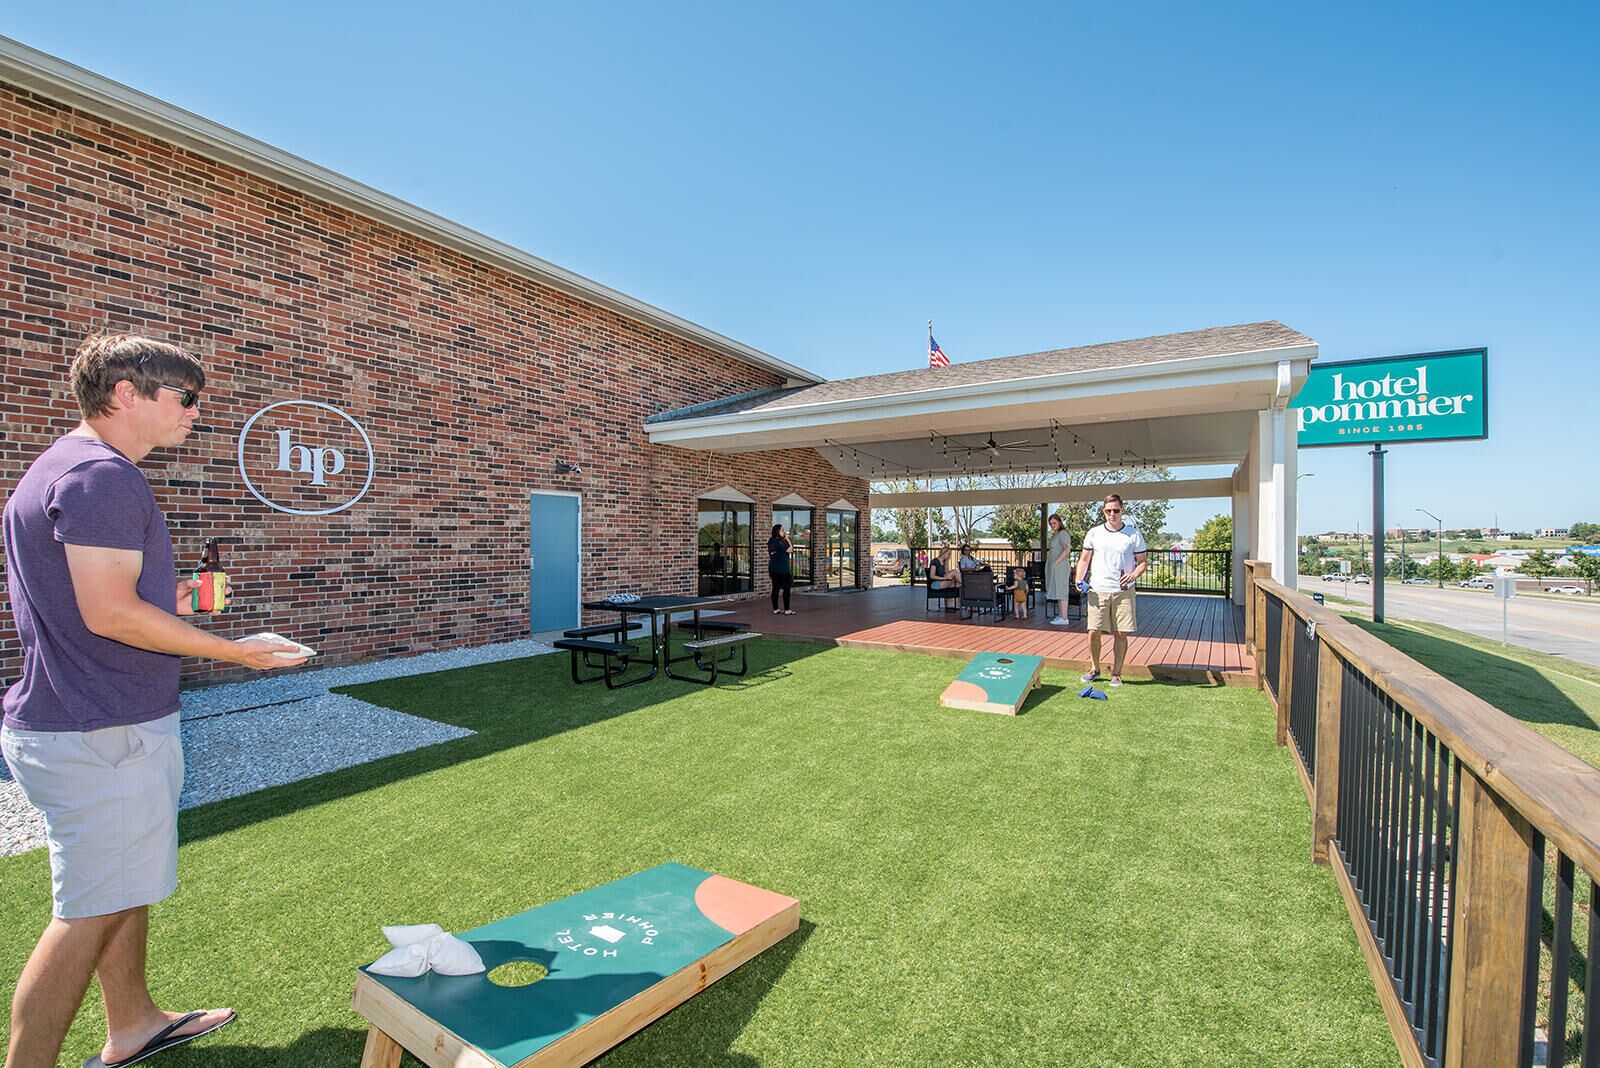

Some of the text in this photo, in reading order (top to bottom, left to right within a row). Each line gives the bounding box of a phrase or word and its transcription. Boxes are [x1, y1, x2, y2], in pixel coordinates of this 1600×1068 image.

[1332, 365, 1429, 401] hotel
[1297, 394, 1473, 432] pommier
[1338, 425, 1380, 435] SINCE
[273, 429, 345, 486] hp
[556, 928, 617, 957] HOTEL
[582, 912, 659, 945] POMMIER
